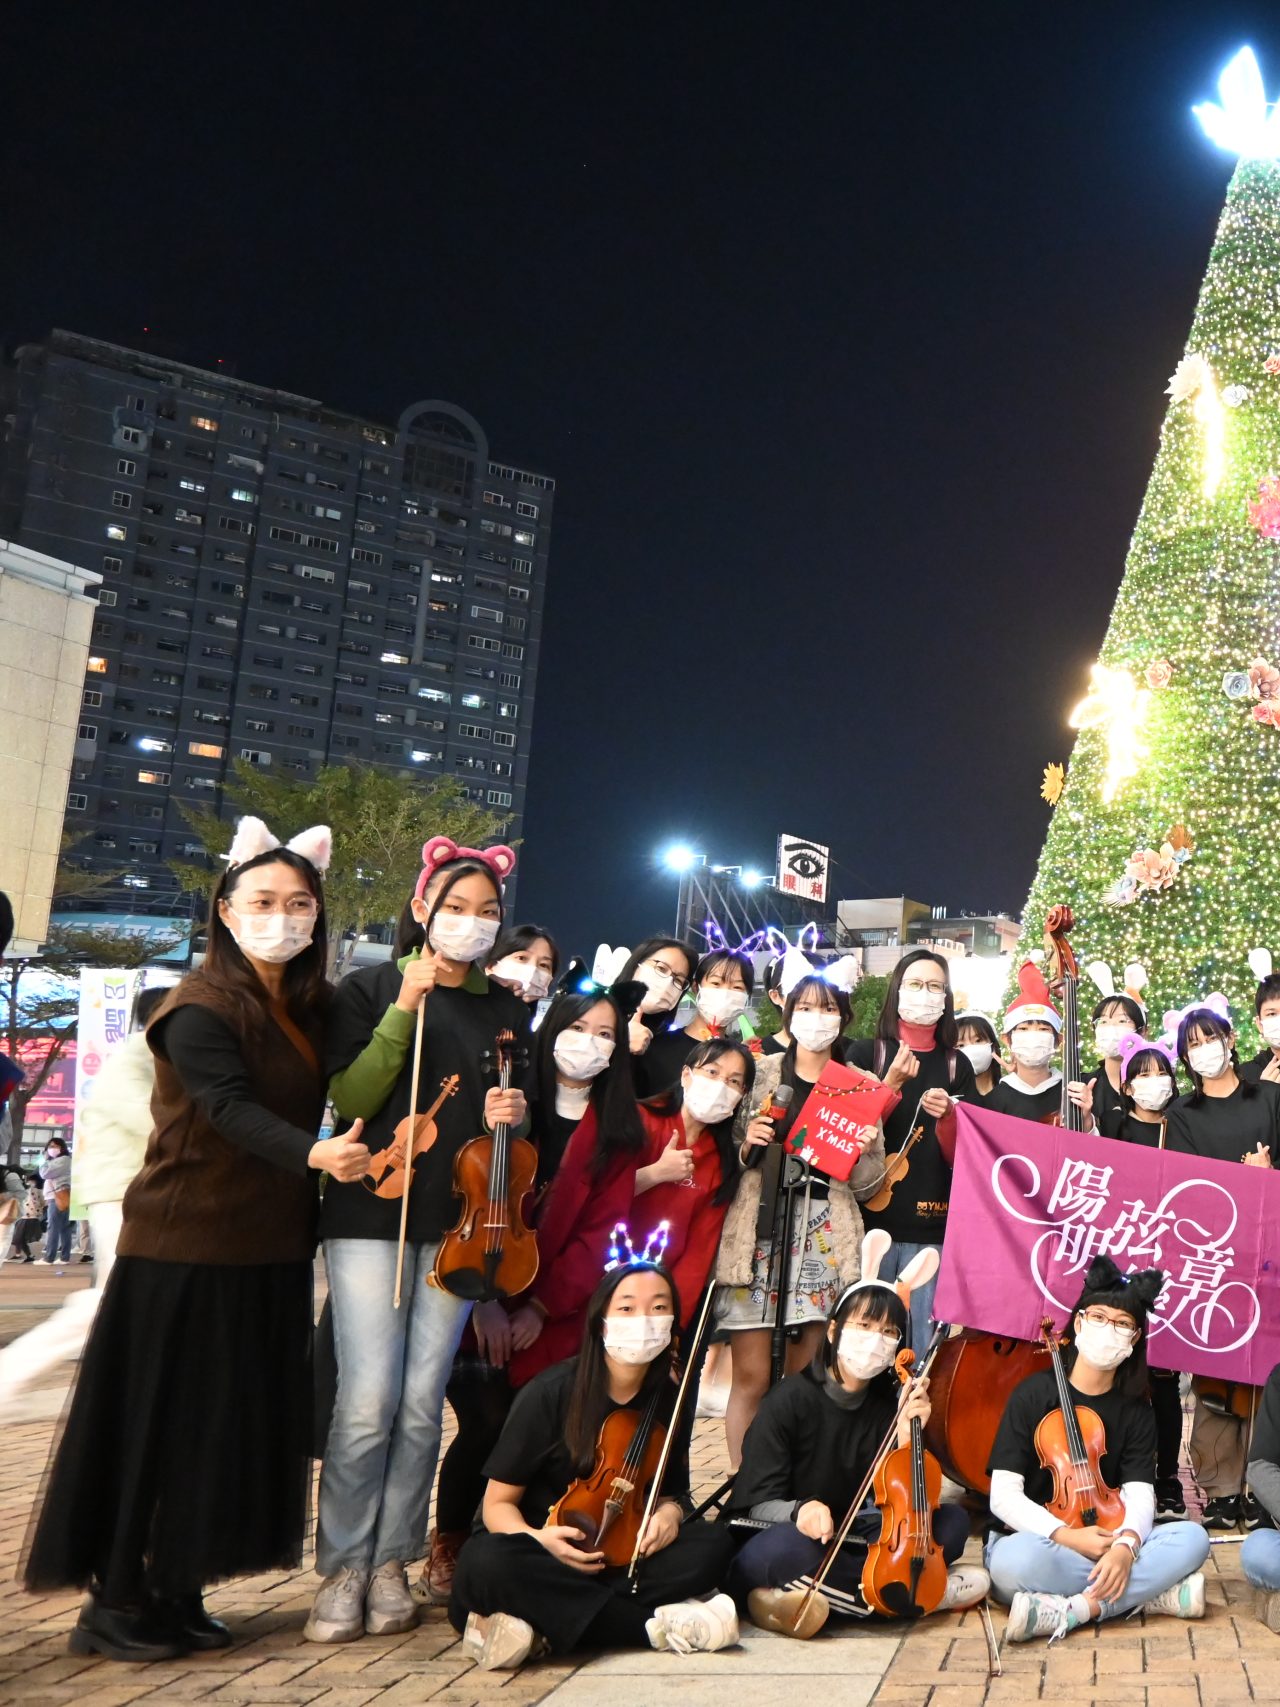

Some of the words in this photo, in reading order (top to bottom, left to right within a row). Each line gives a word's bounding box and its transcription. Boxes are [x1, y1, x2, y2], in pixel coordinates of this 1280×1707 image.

[783, 873, 822, 898] 眼科
[816, 1106, 865, 1138] MERRY
[816, 1126, 855, 1155] X'MAS
